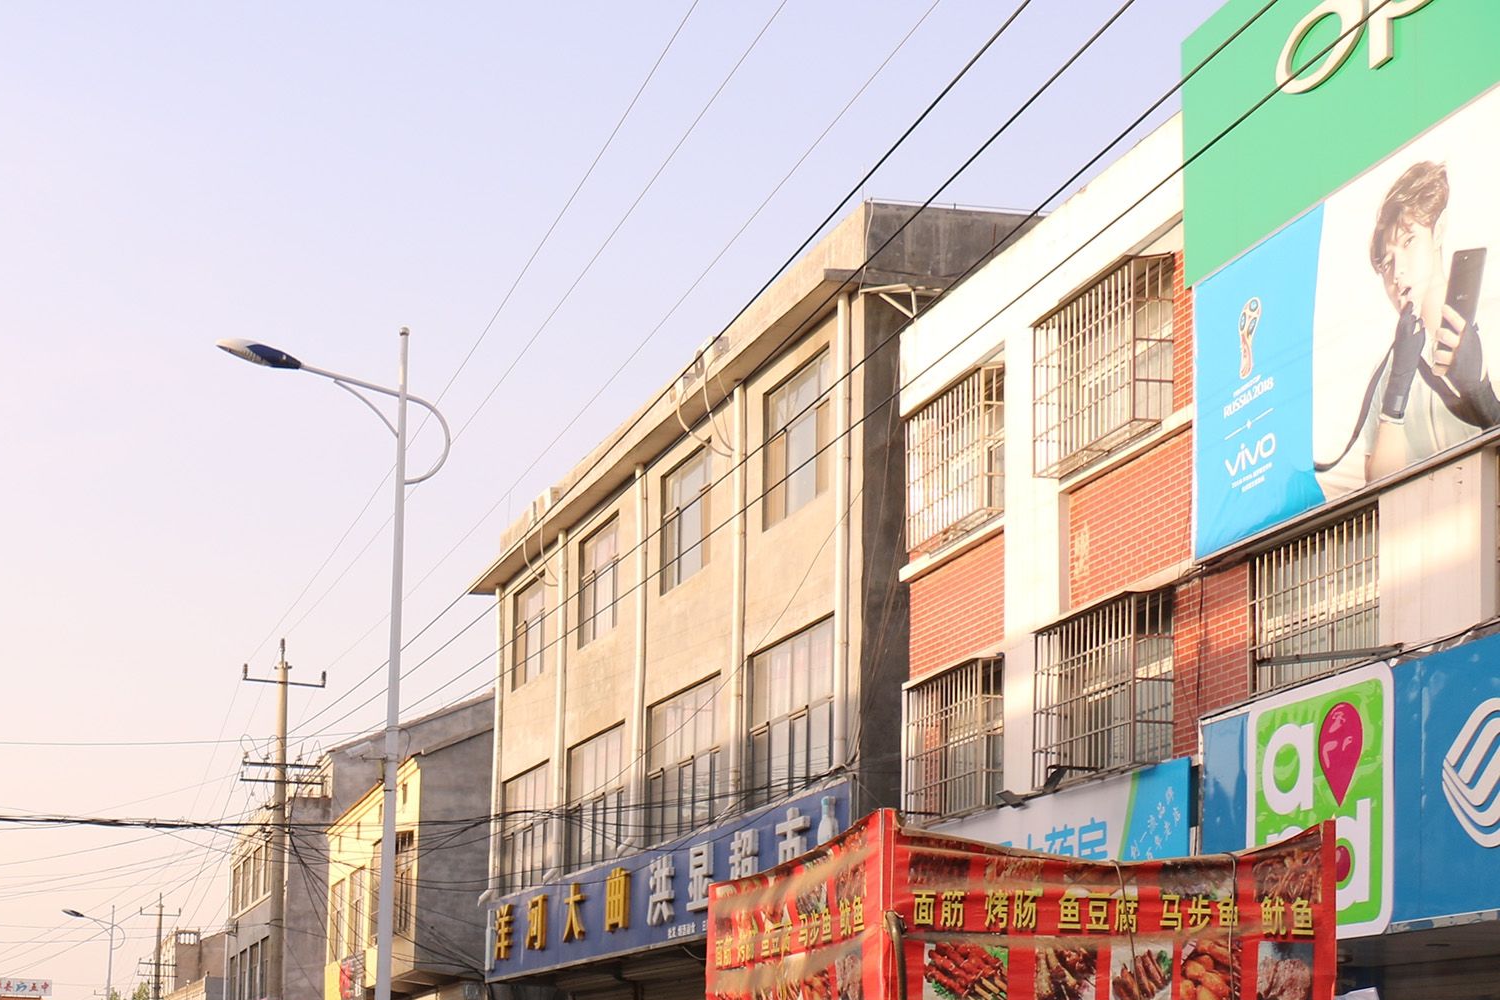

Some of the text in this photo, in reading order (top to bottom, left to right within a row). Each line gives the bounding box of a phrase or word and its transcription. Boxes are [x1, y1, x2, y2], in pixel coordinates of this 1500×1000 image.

[1224, 432, 1276, 477] vivo
[495, 866, 632, 961] 洋河大曲
[912, 889, 1315, 937] 面筋 烤肠 鱼豆腐 马步鱼 鱿鱼
